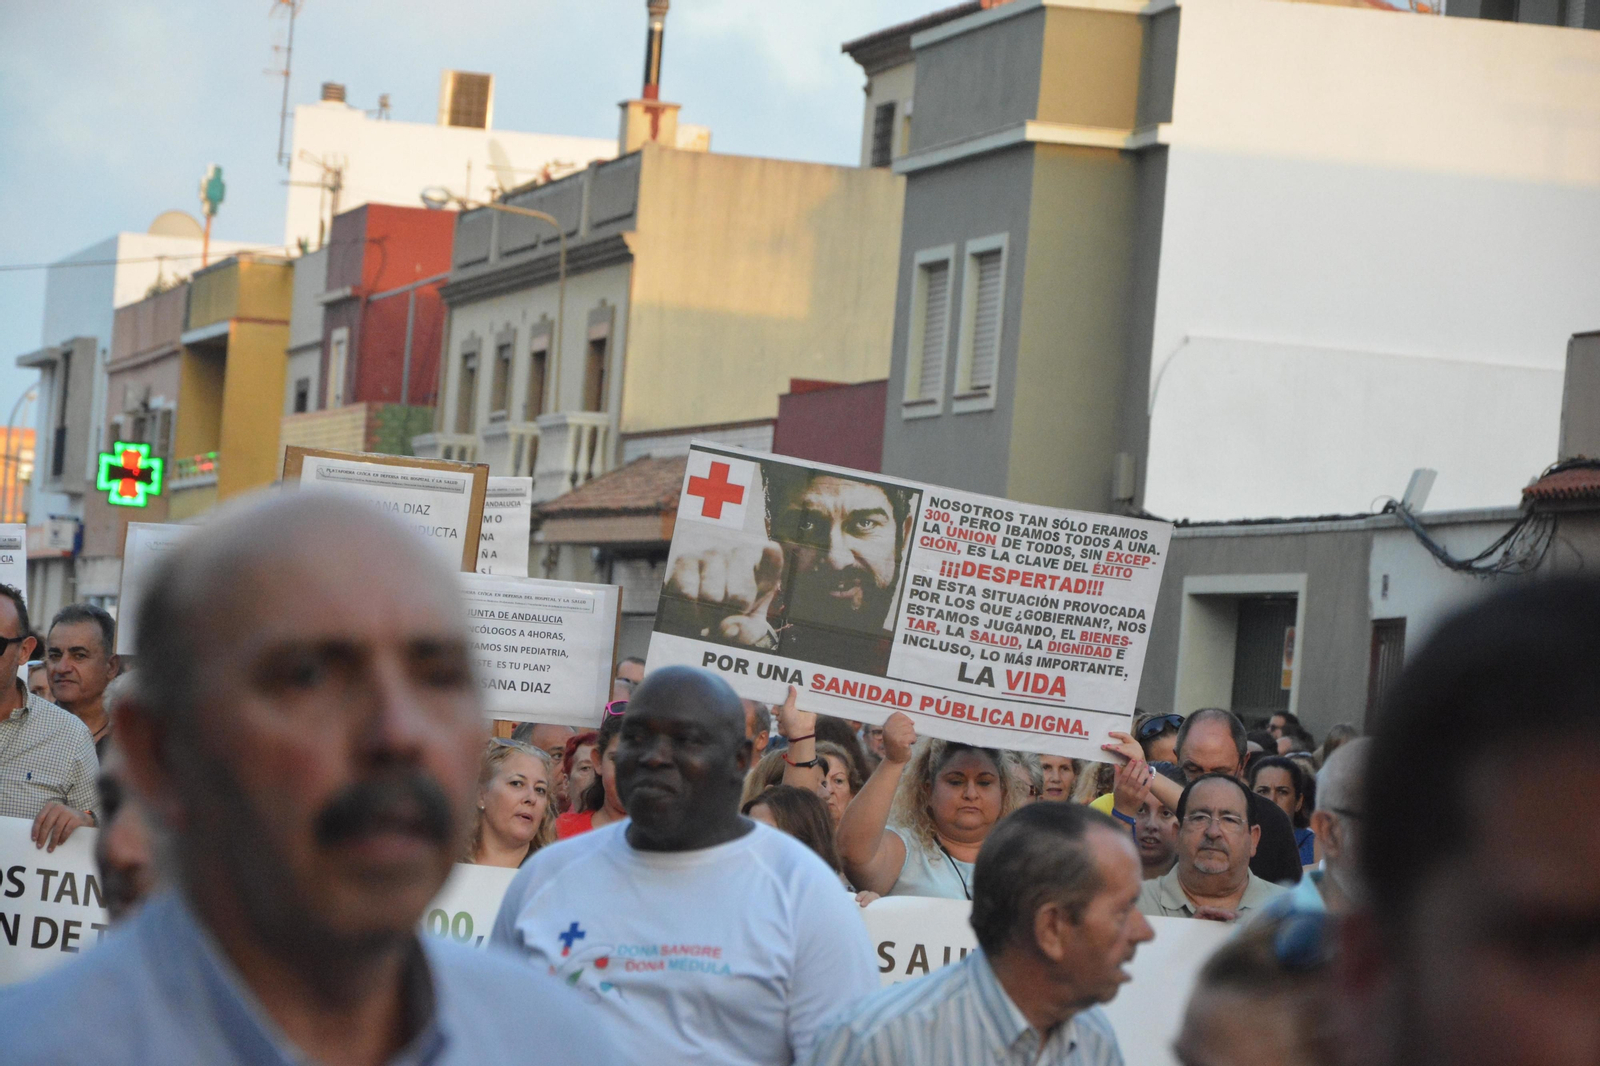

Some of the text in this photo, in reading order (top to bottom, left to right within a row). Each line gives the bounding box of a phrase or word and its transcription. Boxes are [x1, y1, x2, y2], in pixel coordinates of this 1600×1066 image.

[403, 503, 431, 516] DIAZ
[929, 496, 1148, 540] NOSOTROS TAN SÓLO ERAMOS
[922, 522, 940, 535] LA
[1001, 536, 1022, 550] DE
[1026, 541, 1075, 560] TODOS,
[1080, 548, 1102, 560] SIN
[924, 508, 1160, 556] 300, PERO IBAMOS TODOS A UNA.
[920, 535, 1133, 578] CIÓN, ES LA CLAVE DEL ÉXITO
[467, 608, 563, 623] JUNTA DE ANDALUCIA
[909, 588, 1146, 634] POR LOS QUE ¿GOBIERNAN?, NOS
[912, 574, 1146, 620] EN ESTA SITUACIÓN PROVOCADA
[527, 631, 566, 642] 4HORAS,
[906, 603, 1133, 646] ESTAMOS JUGANDO, EL BIENES-
[907, 617, 1125, 660] TAR, LA SALUD, LA DIGNIDAD E
[504, 645, 518, 653] SIN
[521, 646, 569, 659] PEDIATRIA,
[509, 662, 520, 670] TU
[523, 663, 551, 672] PLAN?
[903, 634, 1128, 681] INCLUSO, LO MÁS IMPORTANTE,
[521, 681, 551, 694] DIAZ
[702, 652, 1089, 736] POR UNA SANIDAD PÚBLICA DIGNA.
[957, 662, 1066, 697] LA VIDA
[36, 868, 107, 908] TAN
[31, 916, 82, 954] DE
[617, 944, 722, 959] DONA SANGRE
[625, 959, 664, 972] DONA
